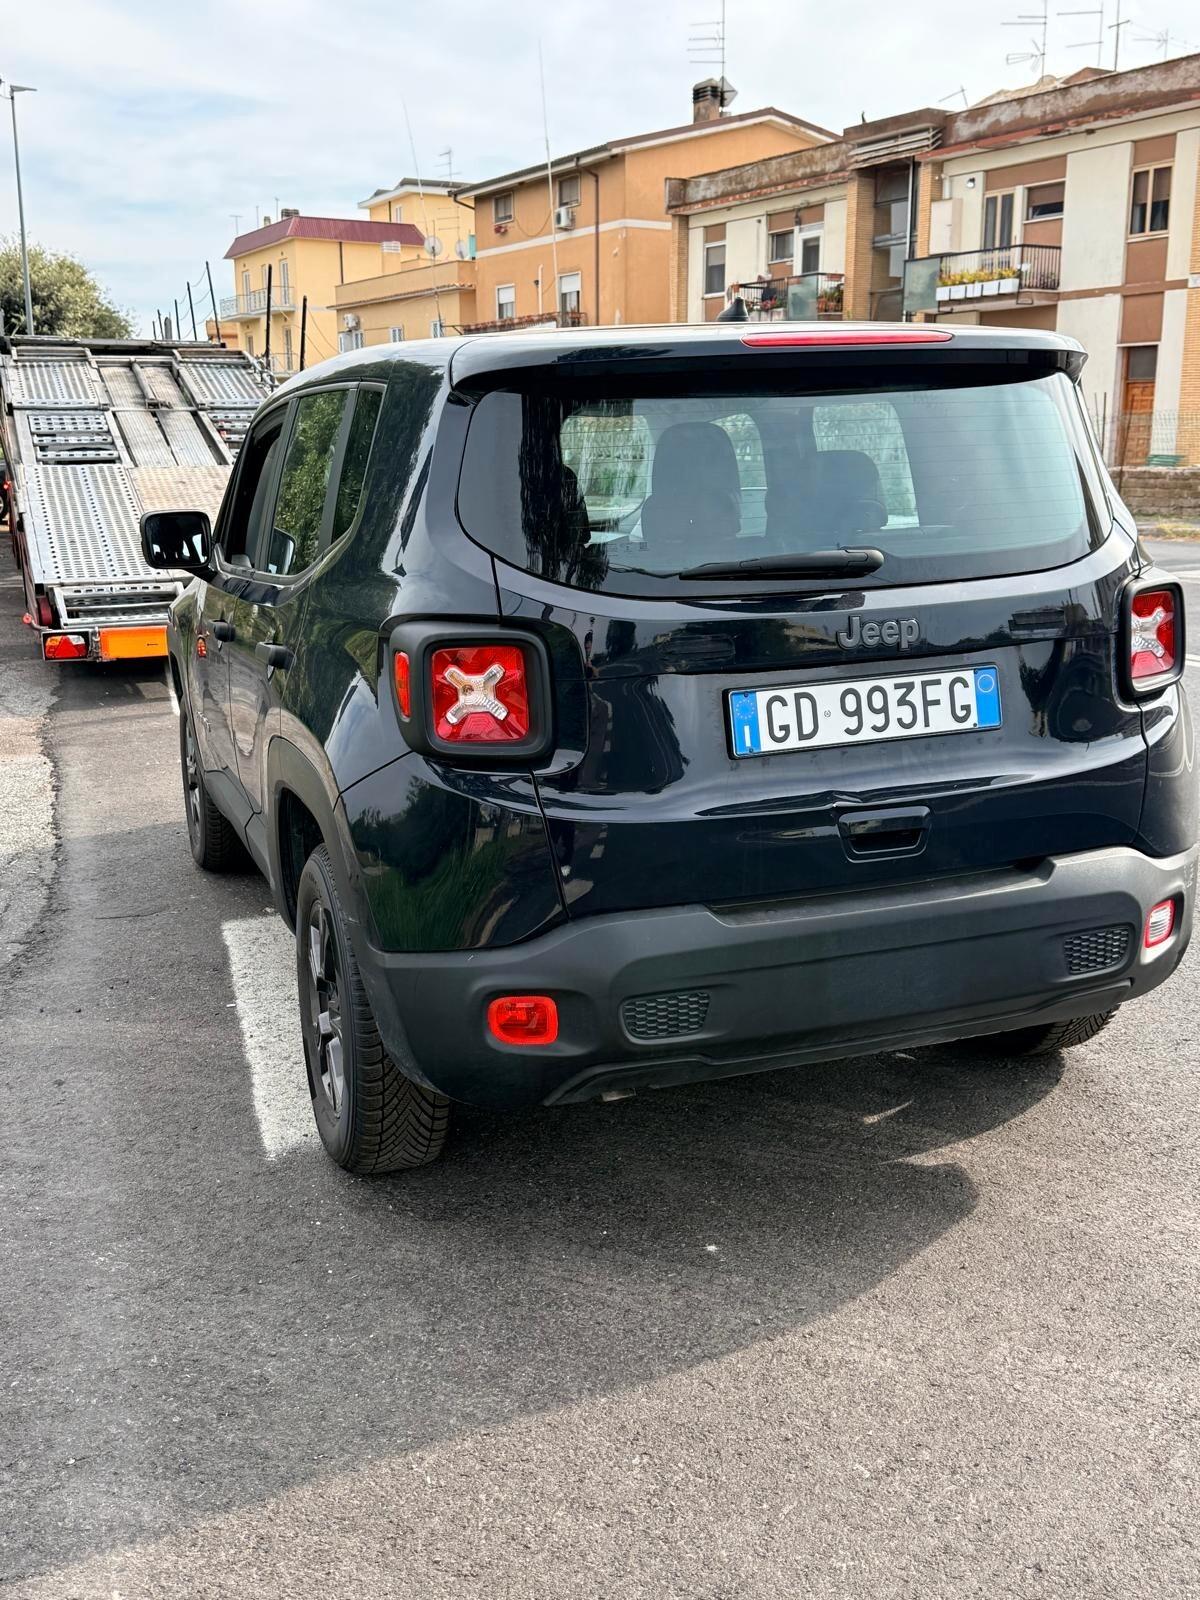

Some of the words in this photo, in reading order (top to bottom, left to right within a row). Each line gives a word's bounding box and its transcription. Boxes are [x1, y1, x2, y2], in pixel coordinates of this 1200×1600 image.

[837, 615, 920, 649] Jeep
[744, 725, 751, 747] I
[766, 692, 819, 743] GD
[840, 676, 971, 736] 993FG
